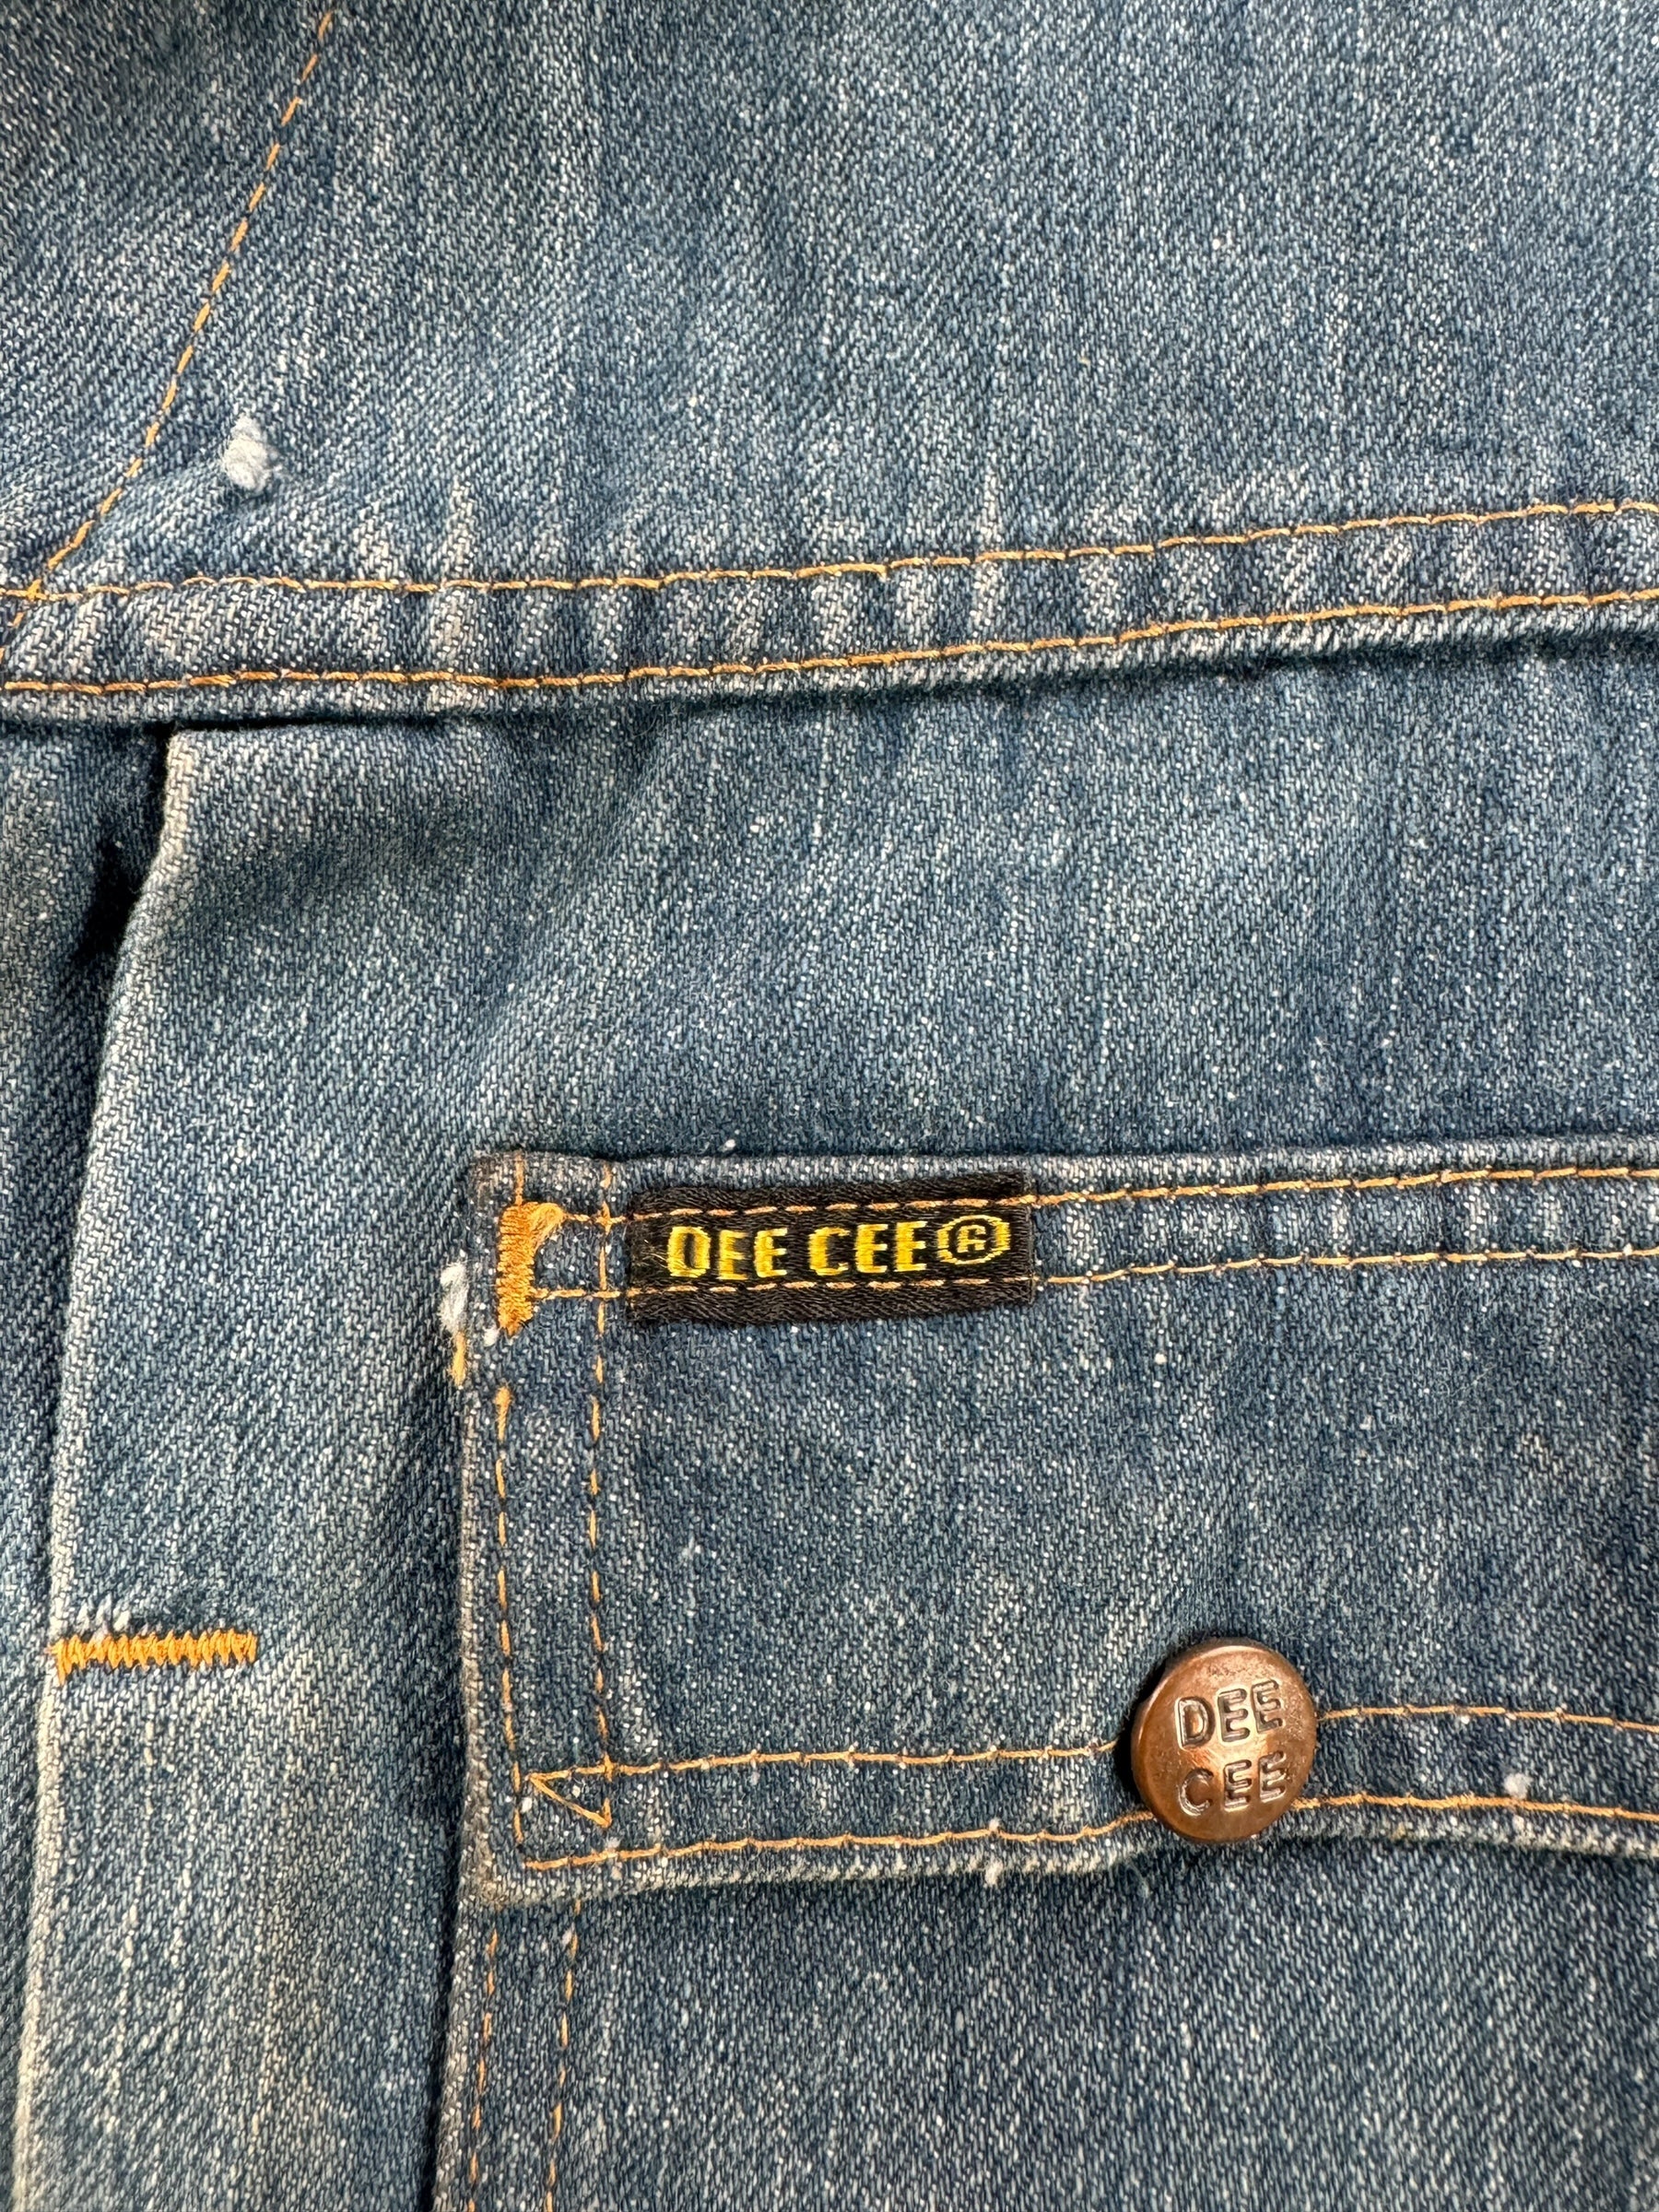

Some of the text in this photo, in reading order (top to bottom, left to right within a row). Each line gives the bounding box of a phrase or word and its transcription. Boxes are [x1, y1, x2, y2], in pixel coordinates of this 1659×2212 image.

[666, 1225, 788, 1280] DEE
[1174, 1677, 1286, 1750] DEE
[1178, 1750, 1288, 1817] CEE
